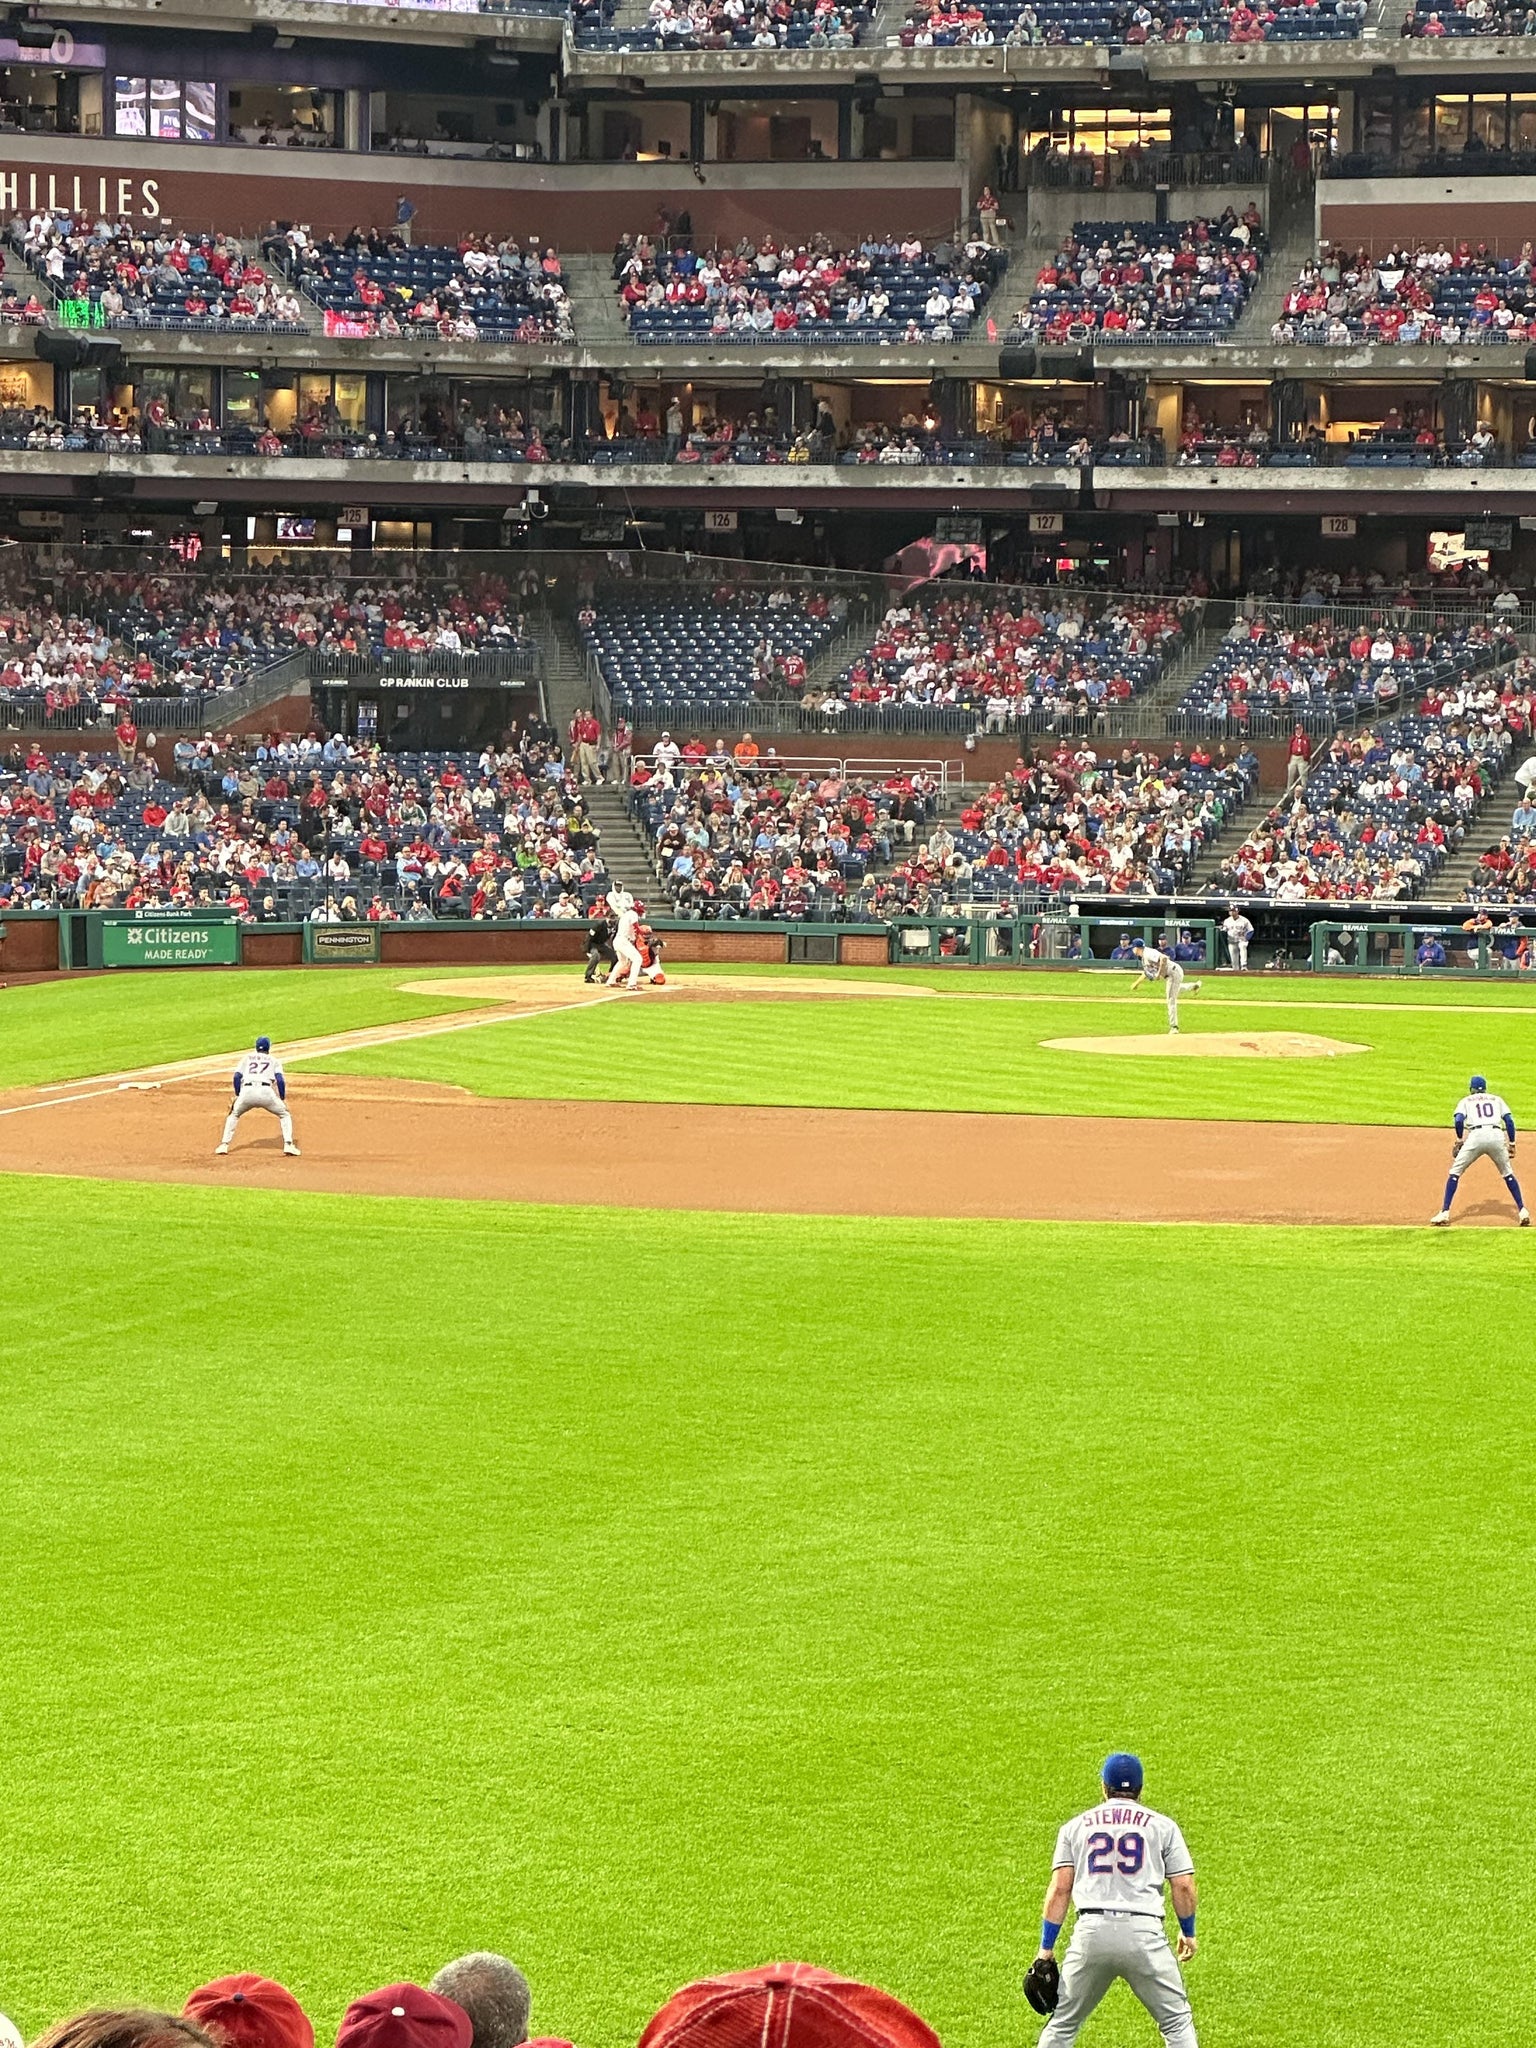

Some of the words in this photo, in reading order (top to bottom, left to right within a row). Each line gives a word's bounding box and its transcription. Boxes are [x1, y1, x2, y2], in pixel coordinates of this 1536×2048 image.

[0, 172, 160, 217] HILLIES
[345, 510, 361, 522] 125
[713, 514, 730, 527] 126
[1037, 516, 1055, 529] 127
[1331, 519, 1348, 531] 128
[380, 678, 395, 687] CP
[395, 678, 434, 687] RANKIN
[436, 678, 469, 688] CLUB
[1164, 919, 1191, 927] RE/MAX
[144, 928, 209, 944] Citizens
[318, 936, 370, 944] PENNINGTON
[144, 949, 173, 959] MADE
[175, 949, 207, 959] READY
[248, 1062, 270, 1074] 27
[1475, 1103, 1494, 1118] 10
[1083, 1807, 1156, 1828] STEWART
[1087, 1831, 1145, 1875] 29
